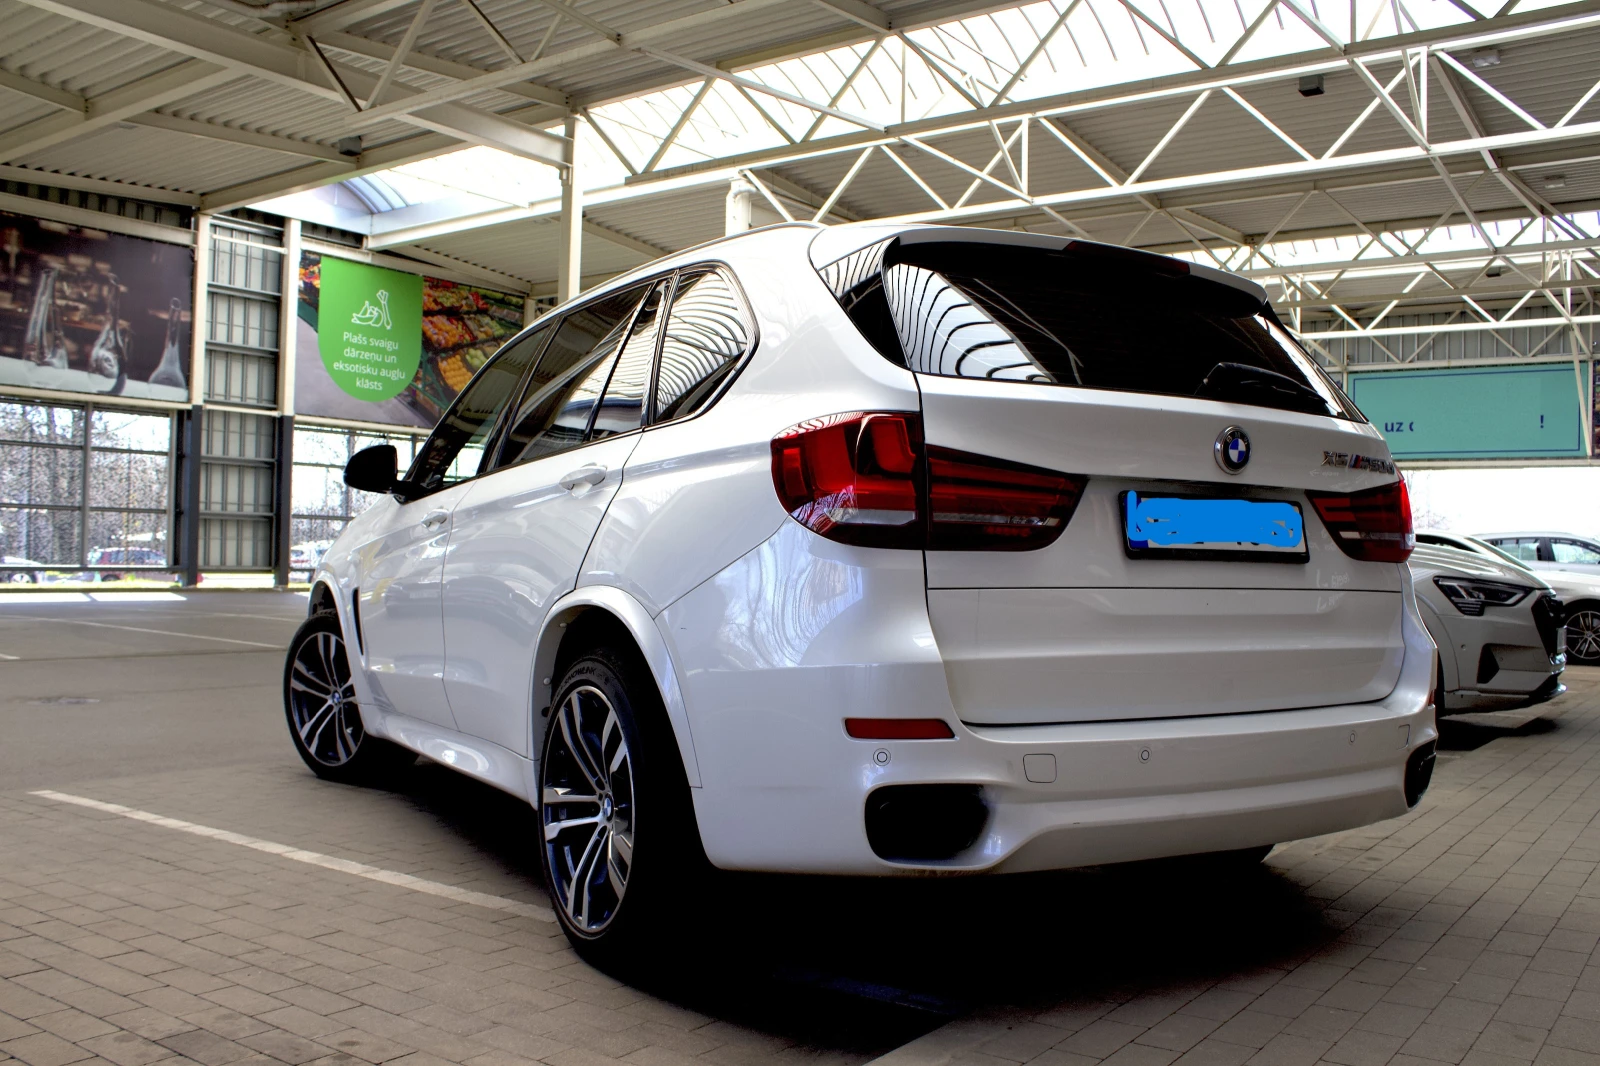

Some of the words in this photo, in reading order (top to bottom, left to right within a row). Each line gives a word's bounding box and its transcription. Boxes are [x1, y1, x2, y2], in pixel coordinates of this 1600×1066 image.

[343, 331, 368, 345] Plašs
[369, 338, 399, 352] svaigu
[343, 346, 382, 363] dārzeņu
[384, 355, 397, 364] un
[333, 360, 378, 376] eksotisku
[380, 368, 406, 381] augļu
[356, 377, 383, 391] klāsts
[1384, 421, 1404, 433] uz
[1321, 450, 1349, 467] X5
